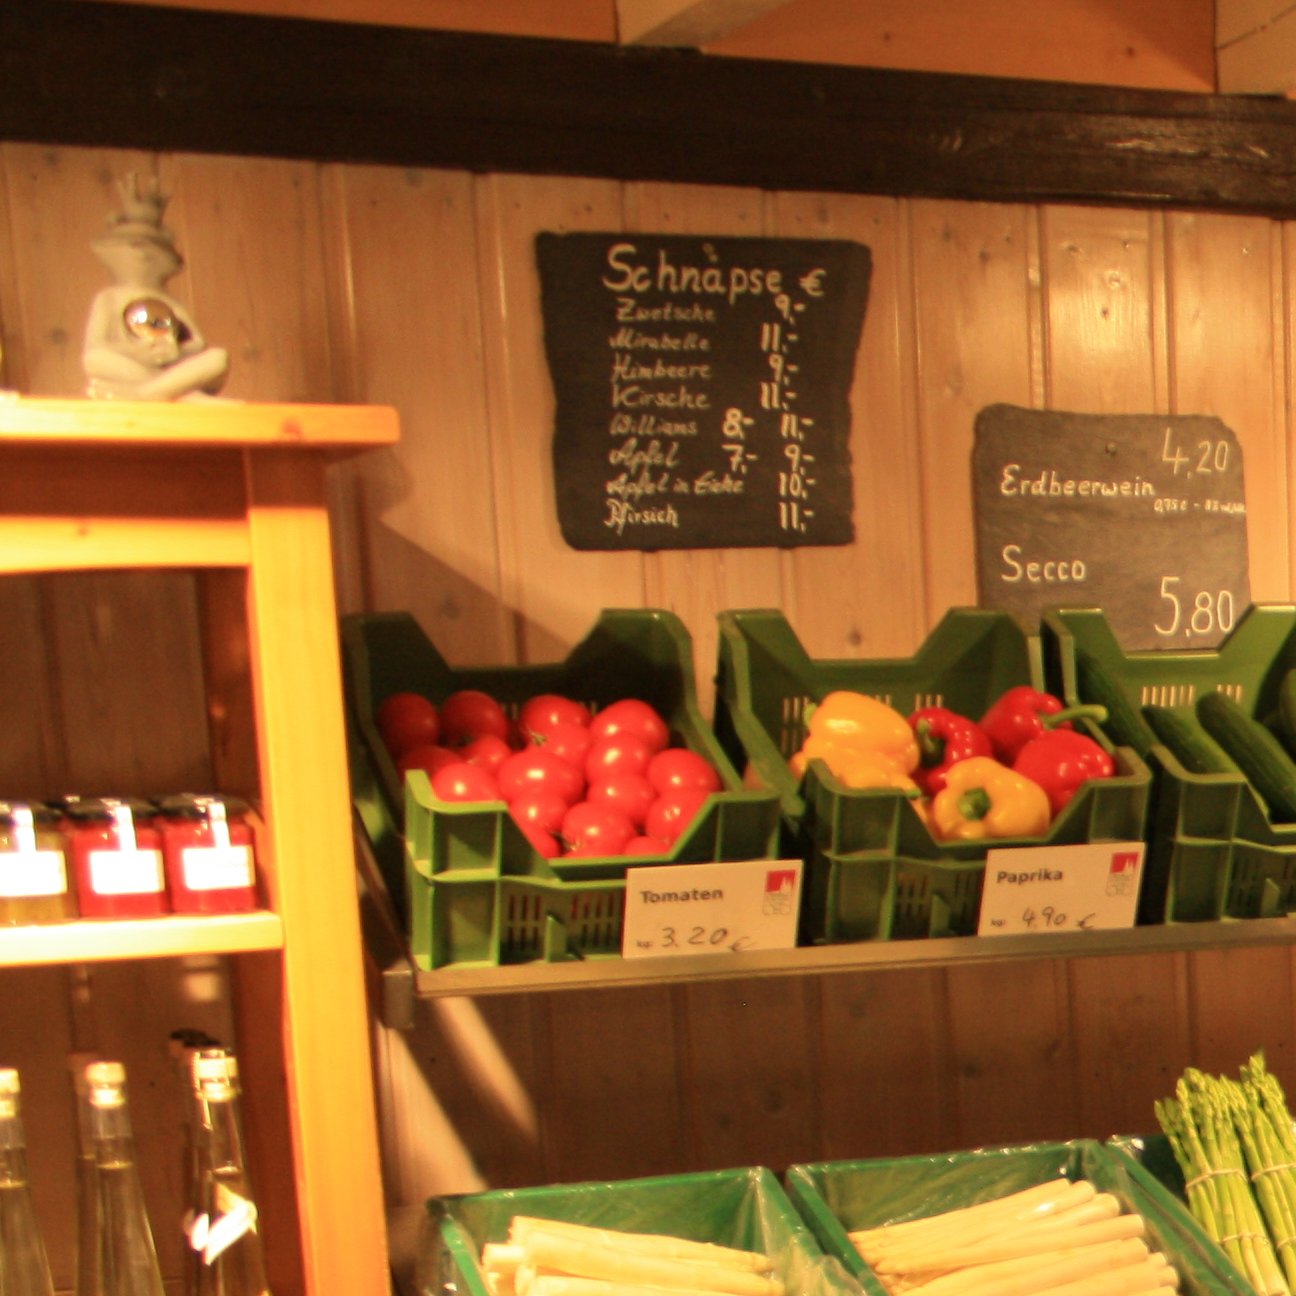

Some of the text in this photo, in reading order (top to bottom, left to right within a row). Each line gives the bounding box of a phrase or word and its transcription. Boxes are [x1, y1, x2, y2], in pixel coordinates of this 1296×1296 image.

[799, 268, 827, 298] €
[609, 327, 711, 350] Mirabelle
[611, 352, 712, 382] Himbeere
[611, 383, 711, 409] Kirsche
[609, 413, 698, 435] Williams
[609, 438, 679, 475] Apfel
[1161, 426, 1229, 479] 4,20
[606, 465, 669, 500] Apfel
[1000, 463, 1156, 498] Erdbeerwein
[603, 498, 679, 536] Pfirsich
[1001, 544, 1086, 581] Secco
[1154, 576, 1234, 638] 5,80
[997, 867, 1064, 886] Paprika
[639, 887, 725, 905] Tomaten
